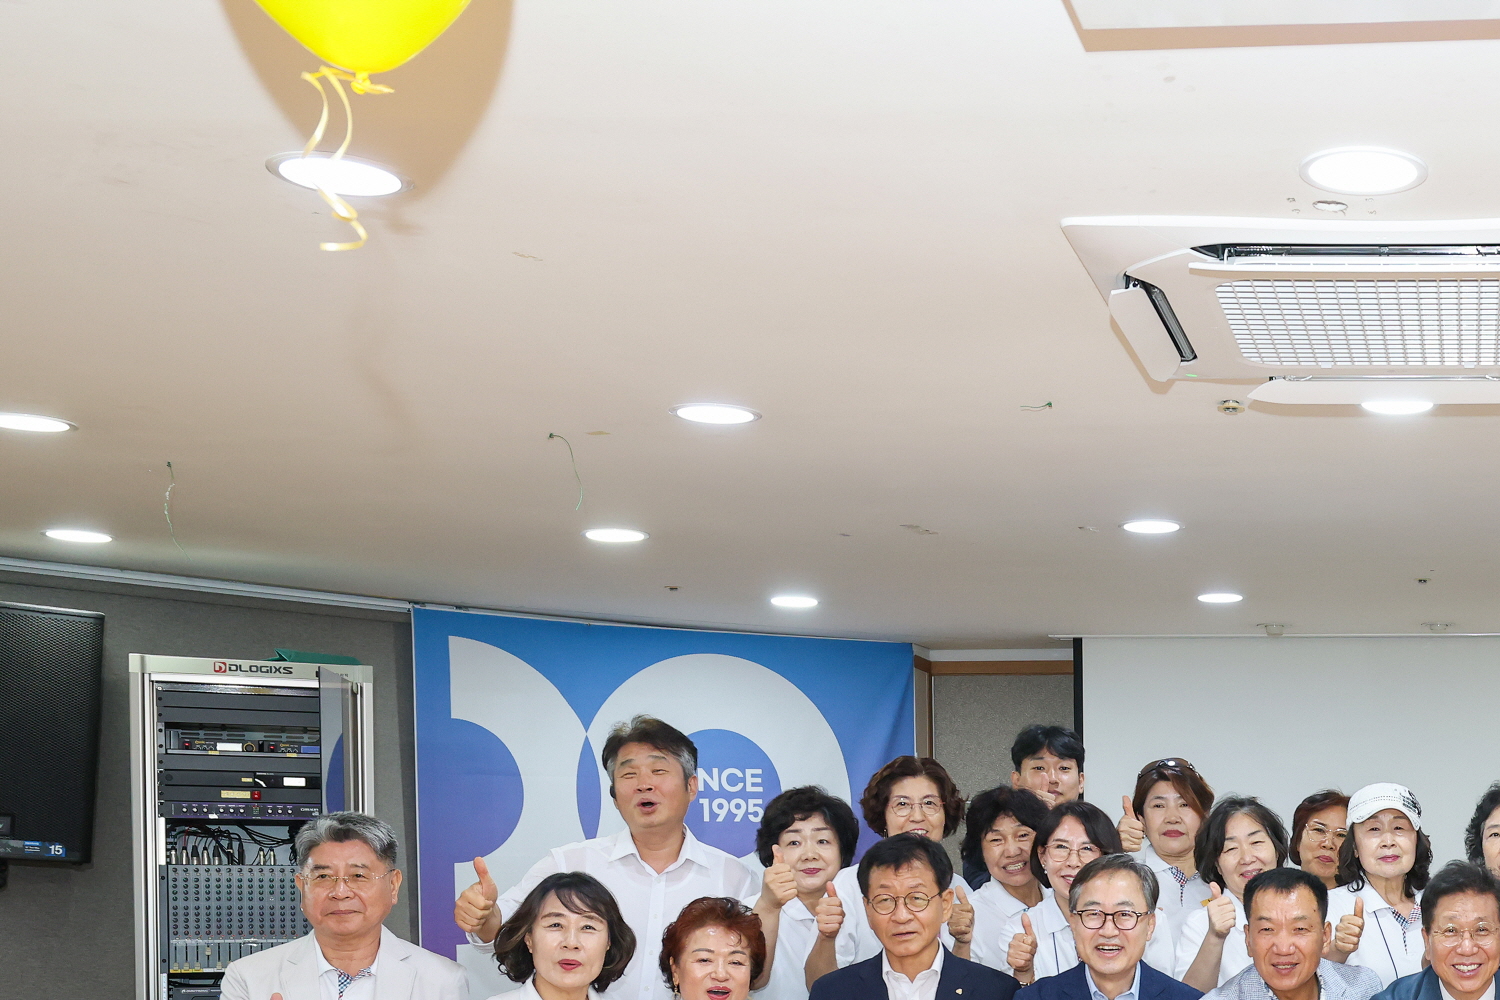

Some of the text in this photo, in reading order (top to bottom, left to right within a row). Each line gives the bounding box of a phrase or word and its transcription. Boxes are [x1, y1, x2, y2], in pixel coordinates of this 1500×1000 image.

[228, 663, 293, 675] DLOGIXS
[697, 767, 764, 793] NCE
[699, 798, 765, 823] 1995
[49, 844, 63, 855] 15
